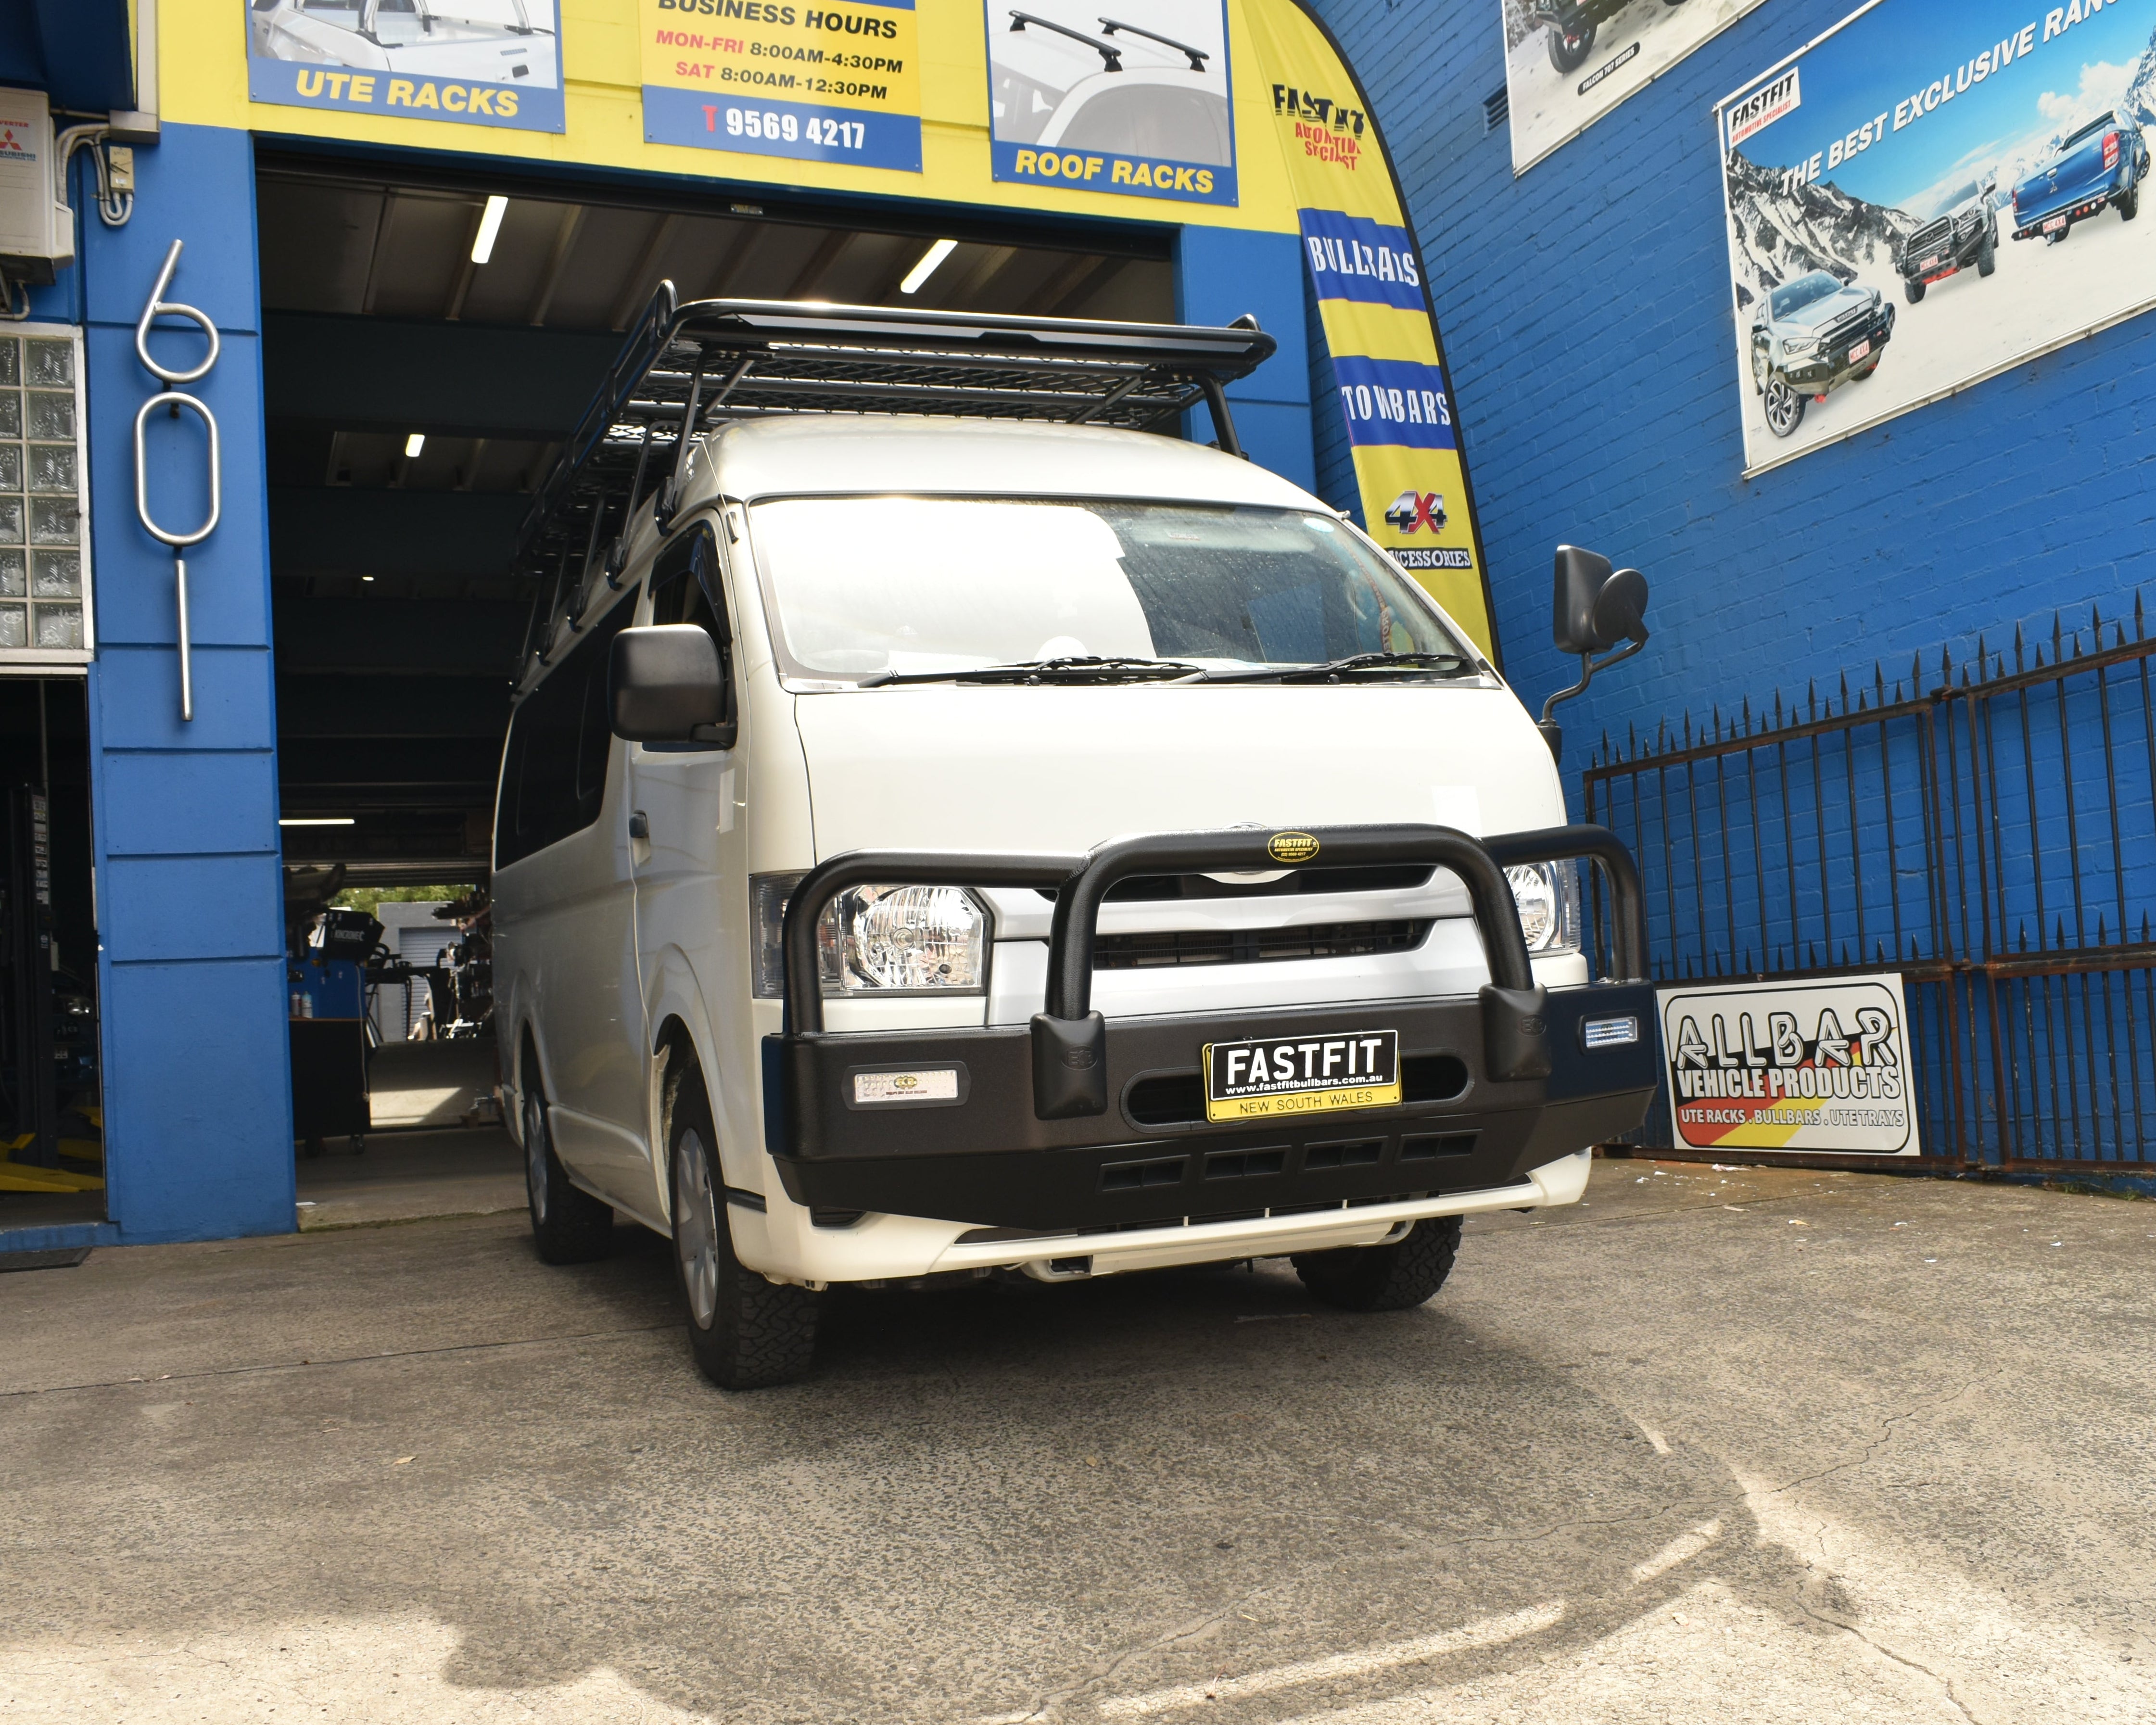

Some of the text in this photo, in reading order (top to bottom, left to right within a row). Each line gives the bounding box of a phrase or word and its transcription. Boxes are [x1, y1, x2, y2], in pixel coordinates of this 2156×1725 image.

[805, 10, 898, 39] HOURS
[655, 30, 903, 74] MON-FRI 8:00AM-4:30PM
[1582, 46, 1635, 91] FALCON 707 SERIES
[296, 69, 519, 117] UTE RACKS
[675, 61, 888, 100] SAT 8:00AM-12:30PM
[1732, 73, 1795, 132] FASTFIT
[1779, 0, 2118, 196] THE BEST EXCLUSIVE RA
[702, 104, 865, 150] T 9569 4217
[1732, 100, 1791, 143] AUTOMOTIVE SPECIALIST
[1015, 149, 1214, 194] ROOF RACKS
[1274, 838, 1313, 848] FASTFIT
[1676, 1007, 1897, 1069] ALLBAR
[1228, 1039, 1382, 1085] FASTFIT
[1677, 1065, 1902, 1100] VEHICLE PRODUCTS
[1226, 1074, 1383, 1095] www.fastfitbullbars.com.au
[1240, 1091, 1373, 1115] NEW SOUTH WALES
[1681, 1109, 1905, 1127] UTE RACKS BULLBARS UTE TRAYS
